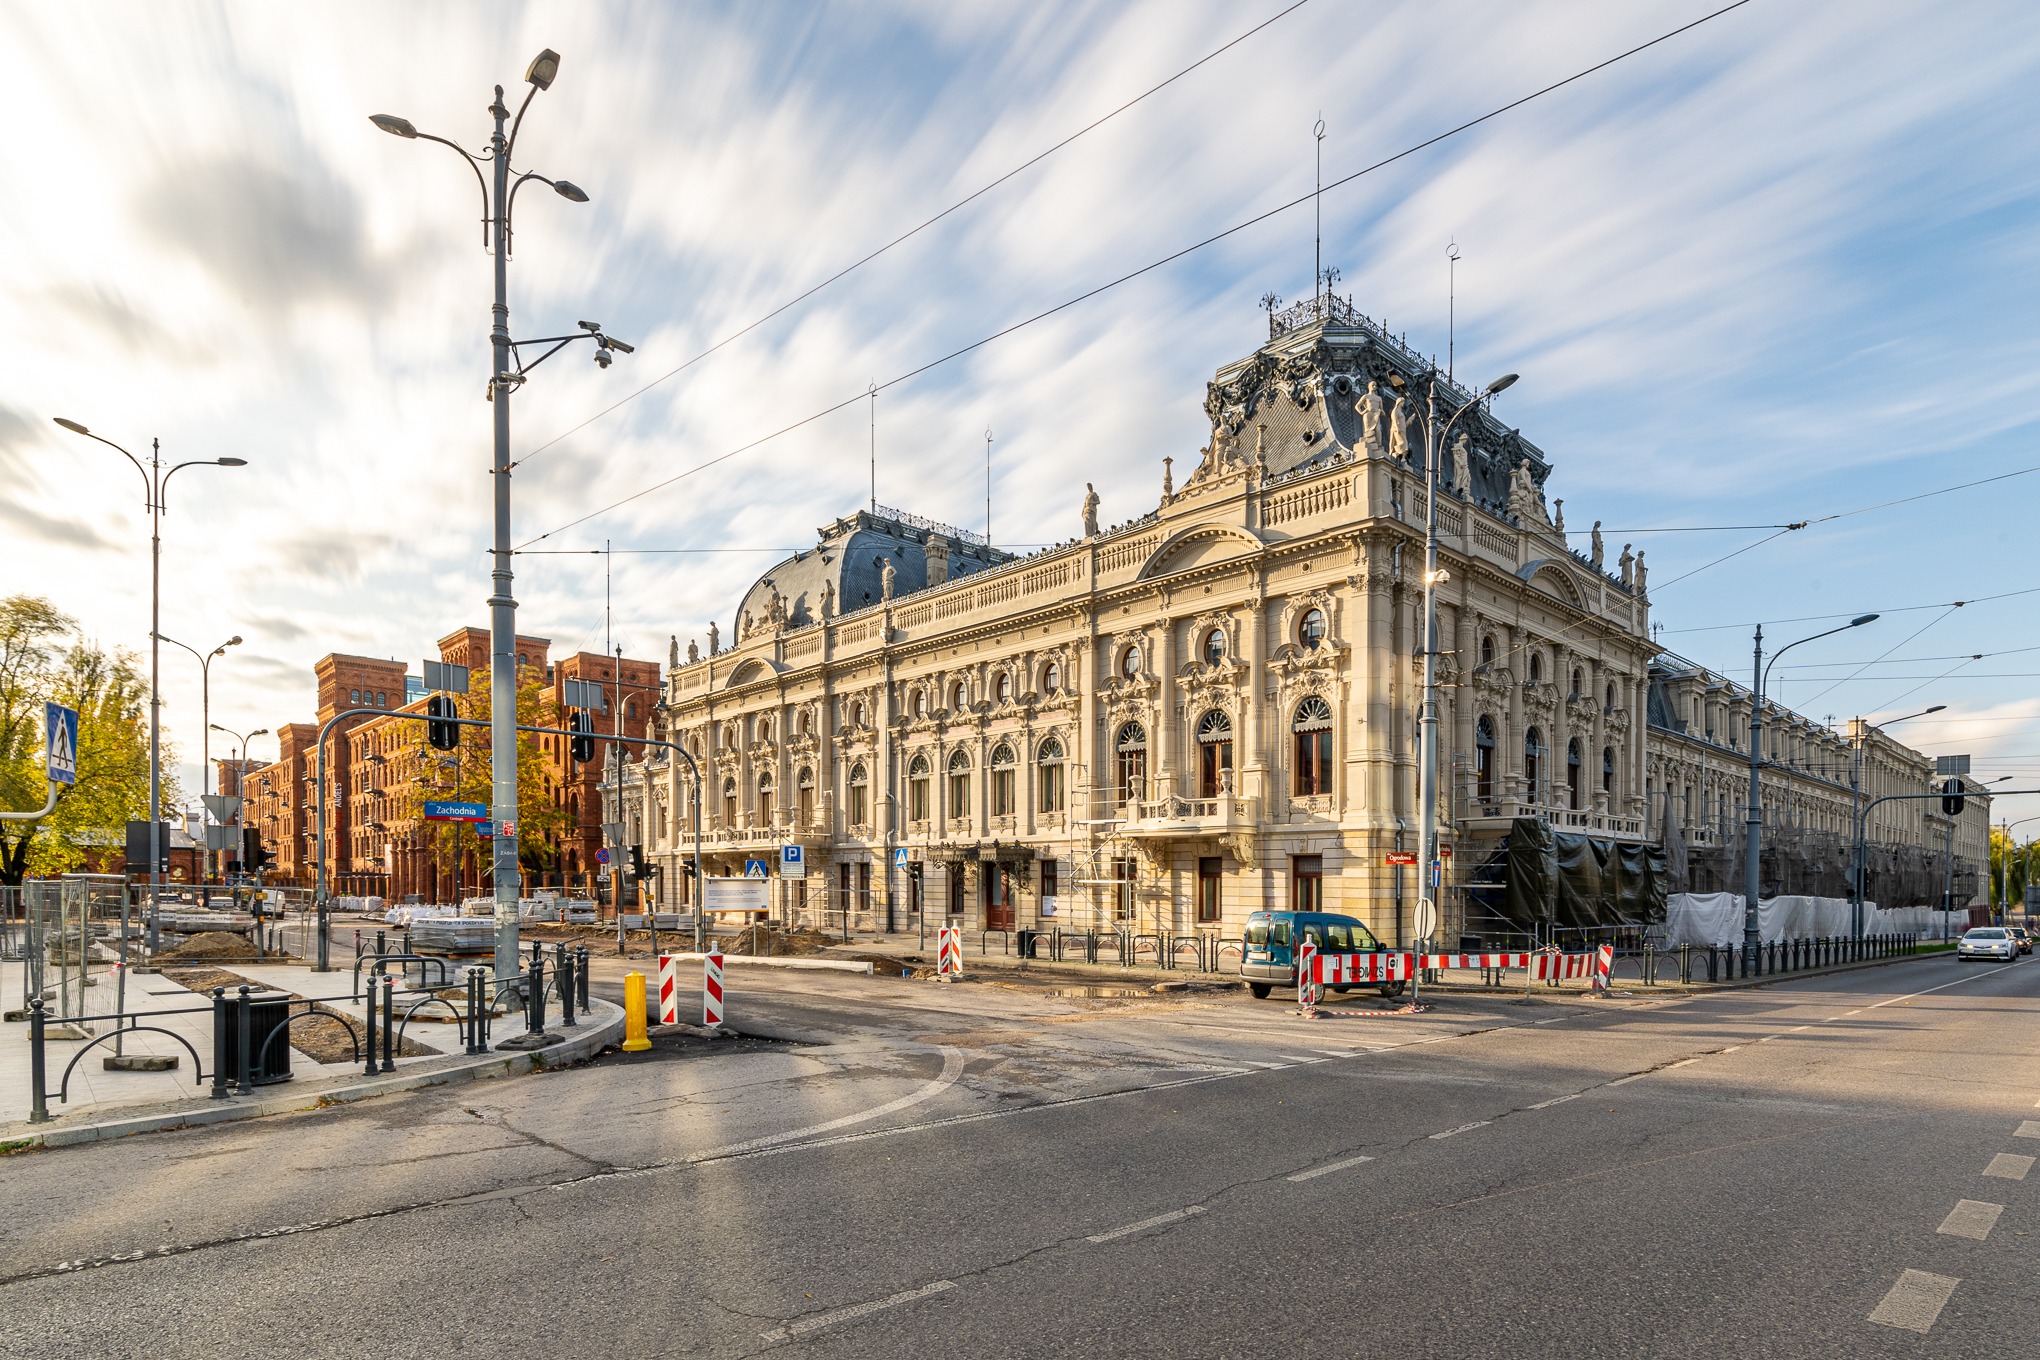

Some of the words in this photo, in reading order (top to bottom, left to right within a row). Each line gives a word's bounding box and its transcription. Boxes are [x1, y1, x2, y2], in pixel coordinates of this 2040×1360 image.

[436, 805, 476, 816] Zachodnia
[1389, 854, 1412, 862] Ogrodowa
[1346, 966, 1384, 979] SZMIGIEL
